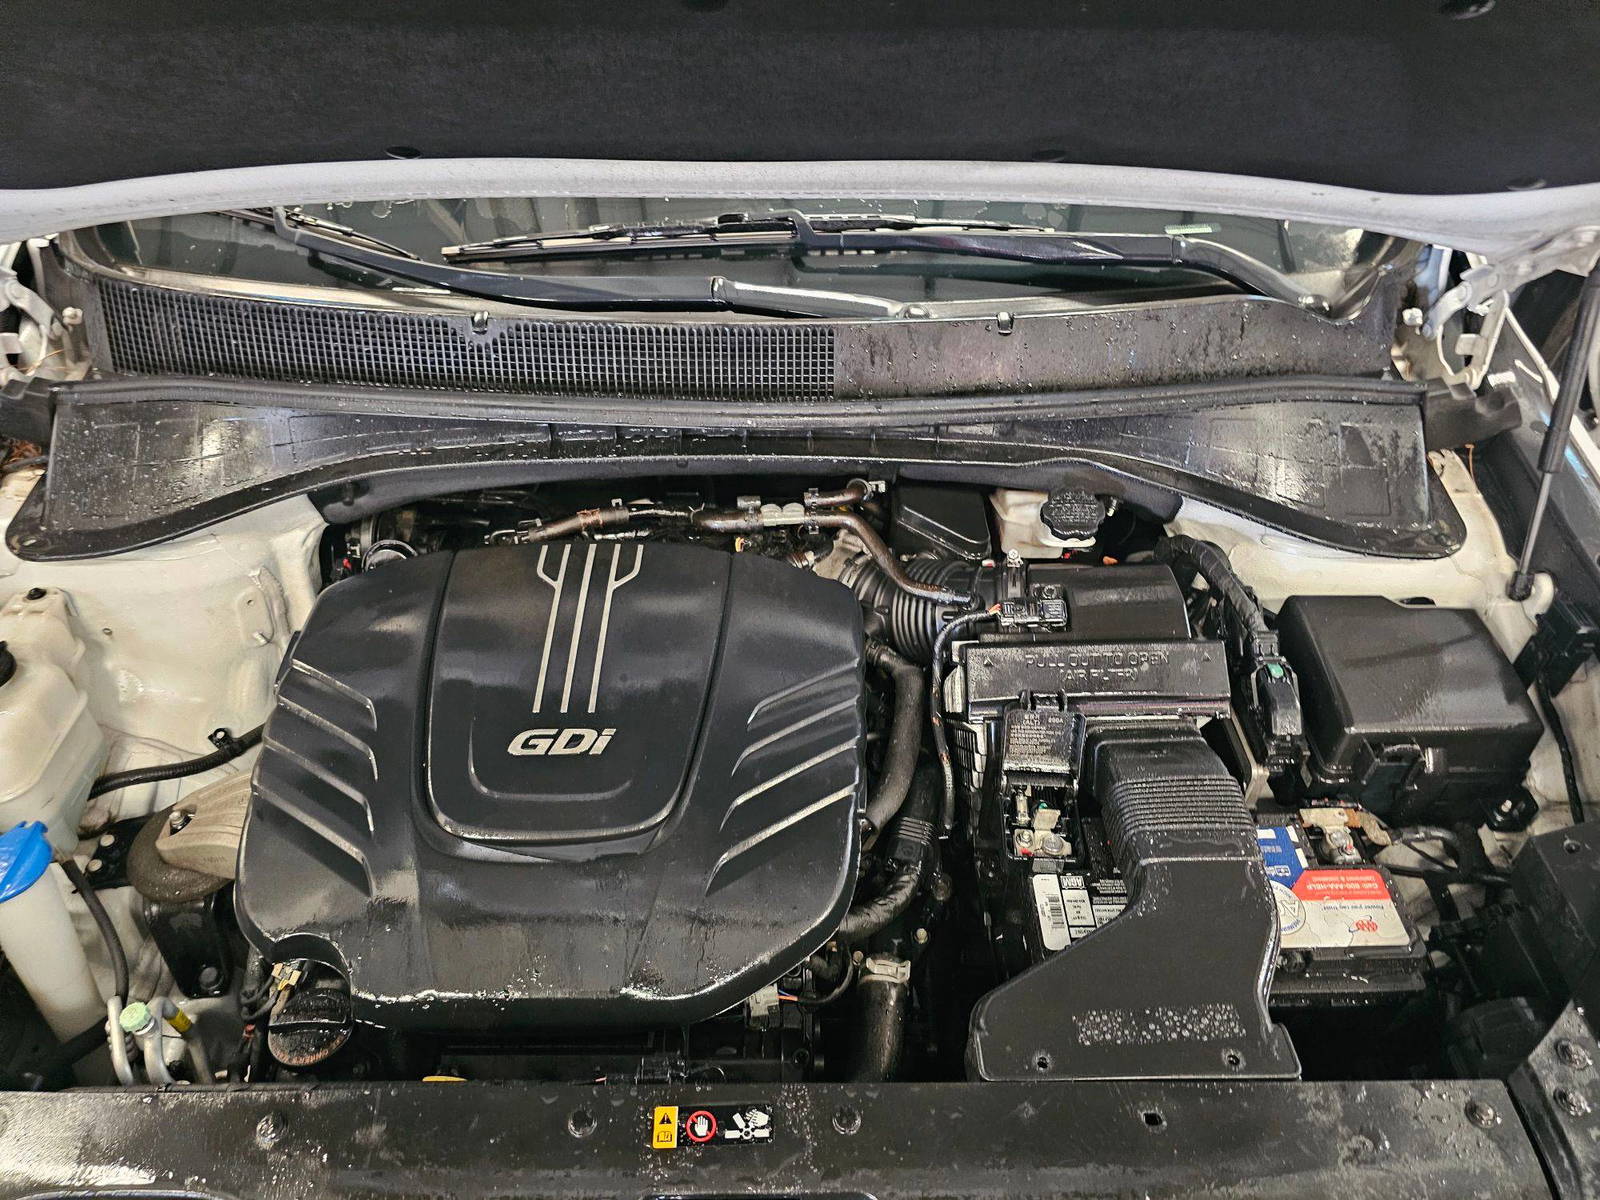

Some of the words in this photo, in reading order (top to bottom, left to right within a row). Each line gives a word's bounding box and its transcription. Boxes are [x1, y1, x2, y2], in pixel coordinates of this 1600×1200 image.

[1025, 653, 1065, 668] PULL
[1068, 652, 1101, 667] OUT
[1103, 652, 1123, 665] TO
[1128, 651, 1169, 665] OPEN
[507, 728, 616, 755] GDi
